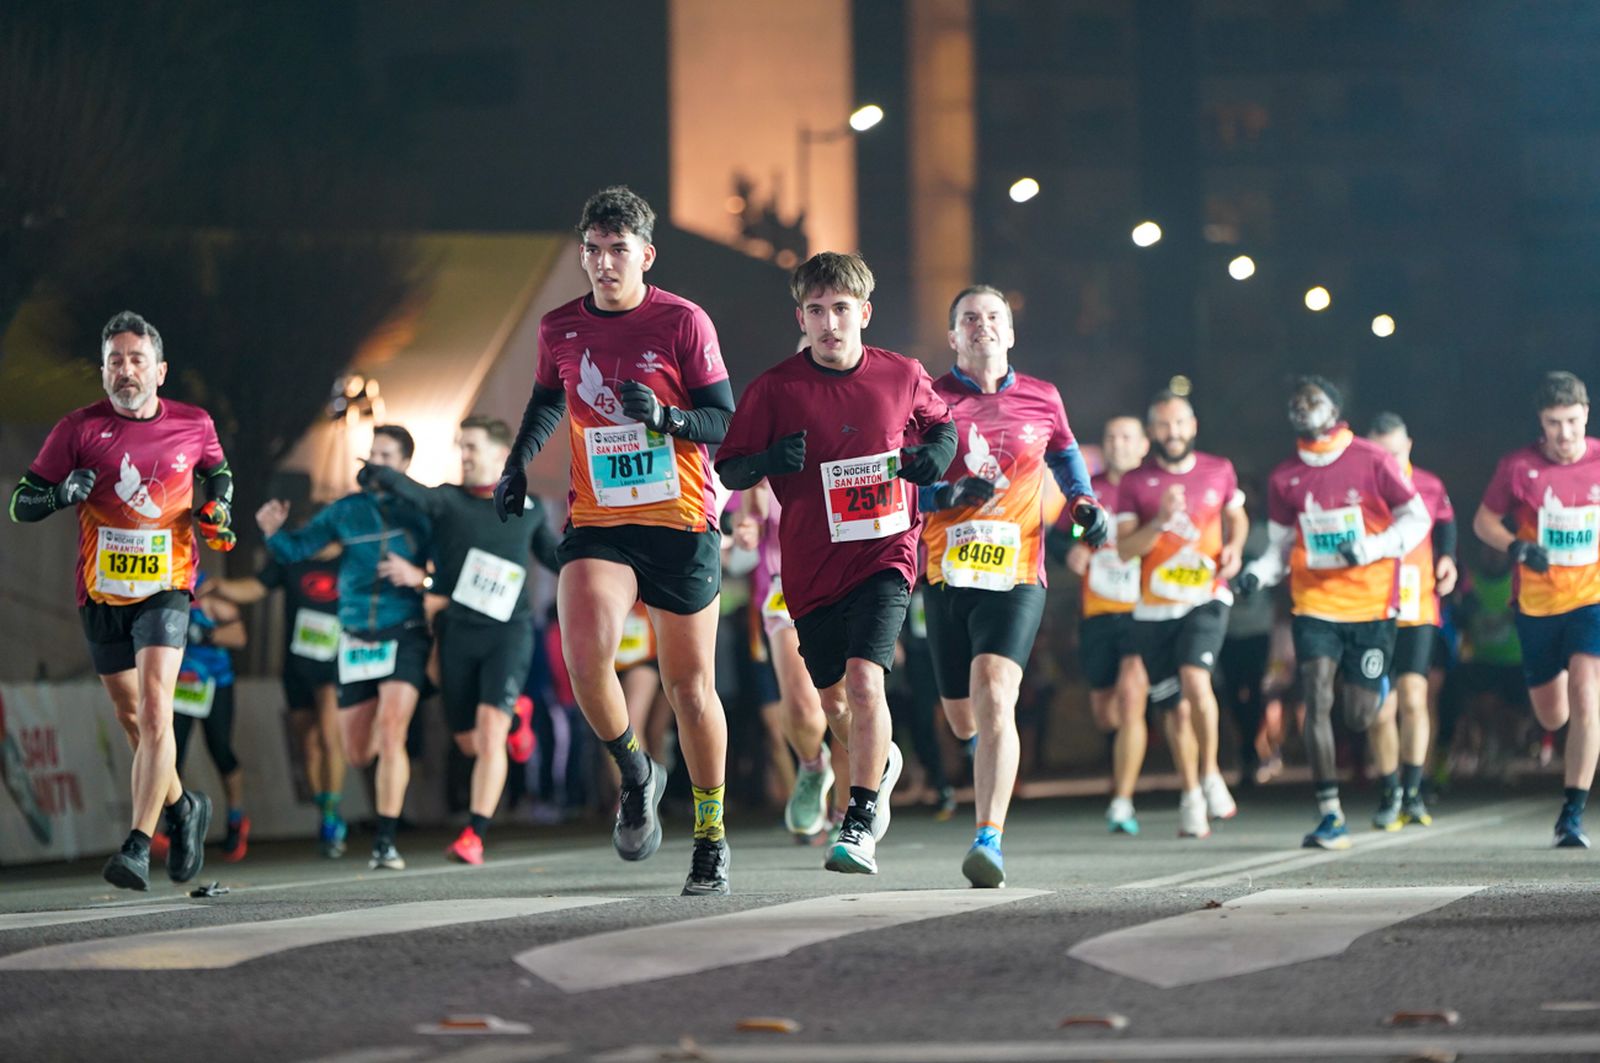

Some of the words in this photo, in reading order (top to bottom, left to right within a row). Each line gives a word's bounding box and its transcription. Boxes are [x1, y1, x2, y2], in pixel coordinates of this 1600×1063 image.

[594, 393, 616, 414] 43
[603, 433, 626, 443] NOCHE
[628, 432, 638, 441] DE
[596, 445, 610, 455] SAN
[607, 451, 653, 479] 7817
[843, 466, 871, 476] NOCHE
[872, 464, 881, 473] DE
[834, 479, 852, 488] SAN
[846, 482, 893, 512] 2547
[1548, 529, 1593, 547] 13640
[108, 553, 159, 574] 13713
[958, 543, 1006, 566] 8469
